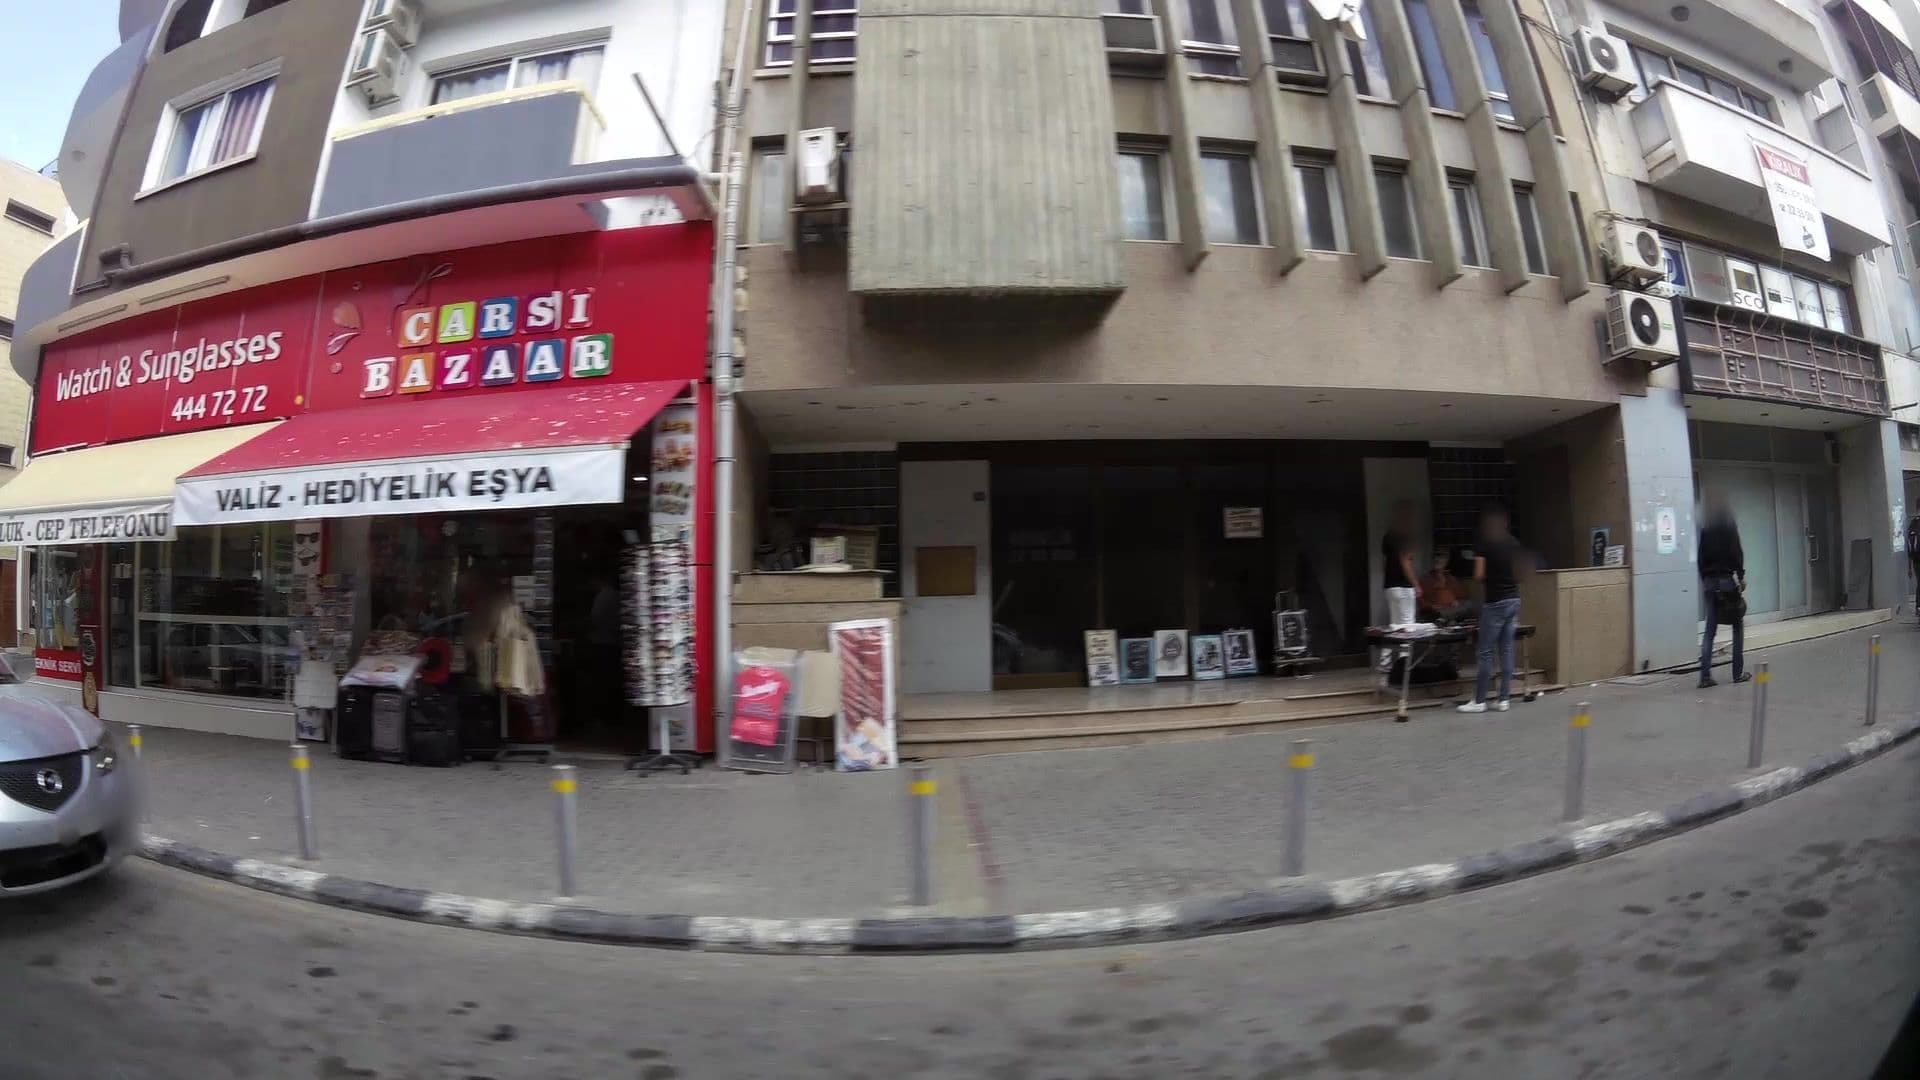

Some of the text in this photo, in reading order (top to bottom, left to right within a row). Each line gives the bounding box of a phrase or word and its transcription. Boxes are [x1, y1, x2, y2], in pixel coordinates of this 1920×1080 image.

[56, 331, 283, 401] Watch & Sunglasses
[364, 340, 609, 391] BAZAAR
[171, 385, 269, 421] 444 72 72
[216, 480, 281, 512] VALİZ
[303, 467, 458, 506] HEDİYELİK
[467, 466, 556, 502] EŞYA
[36, 519, 65, 542] CEP
[69, 513, 169, 540] TELEFONU
